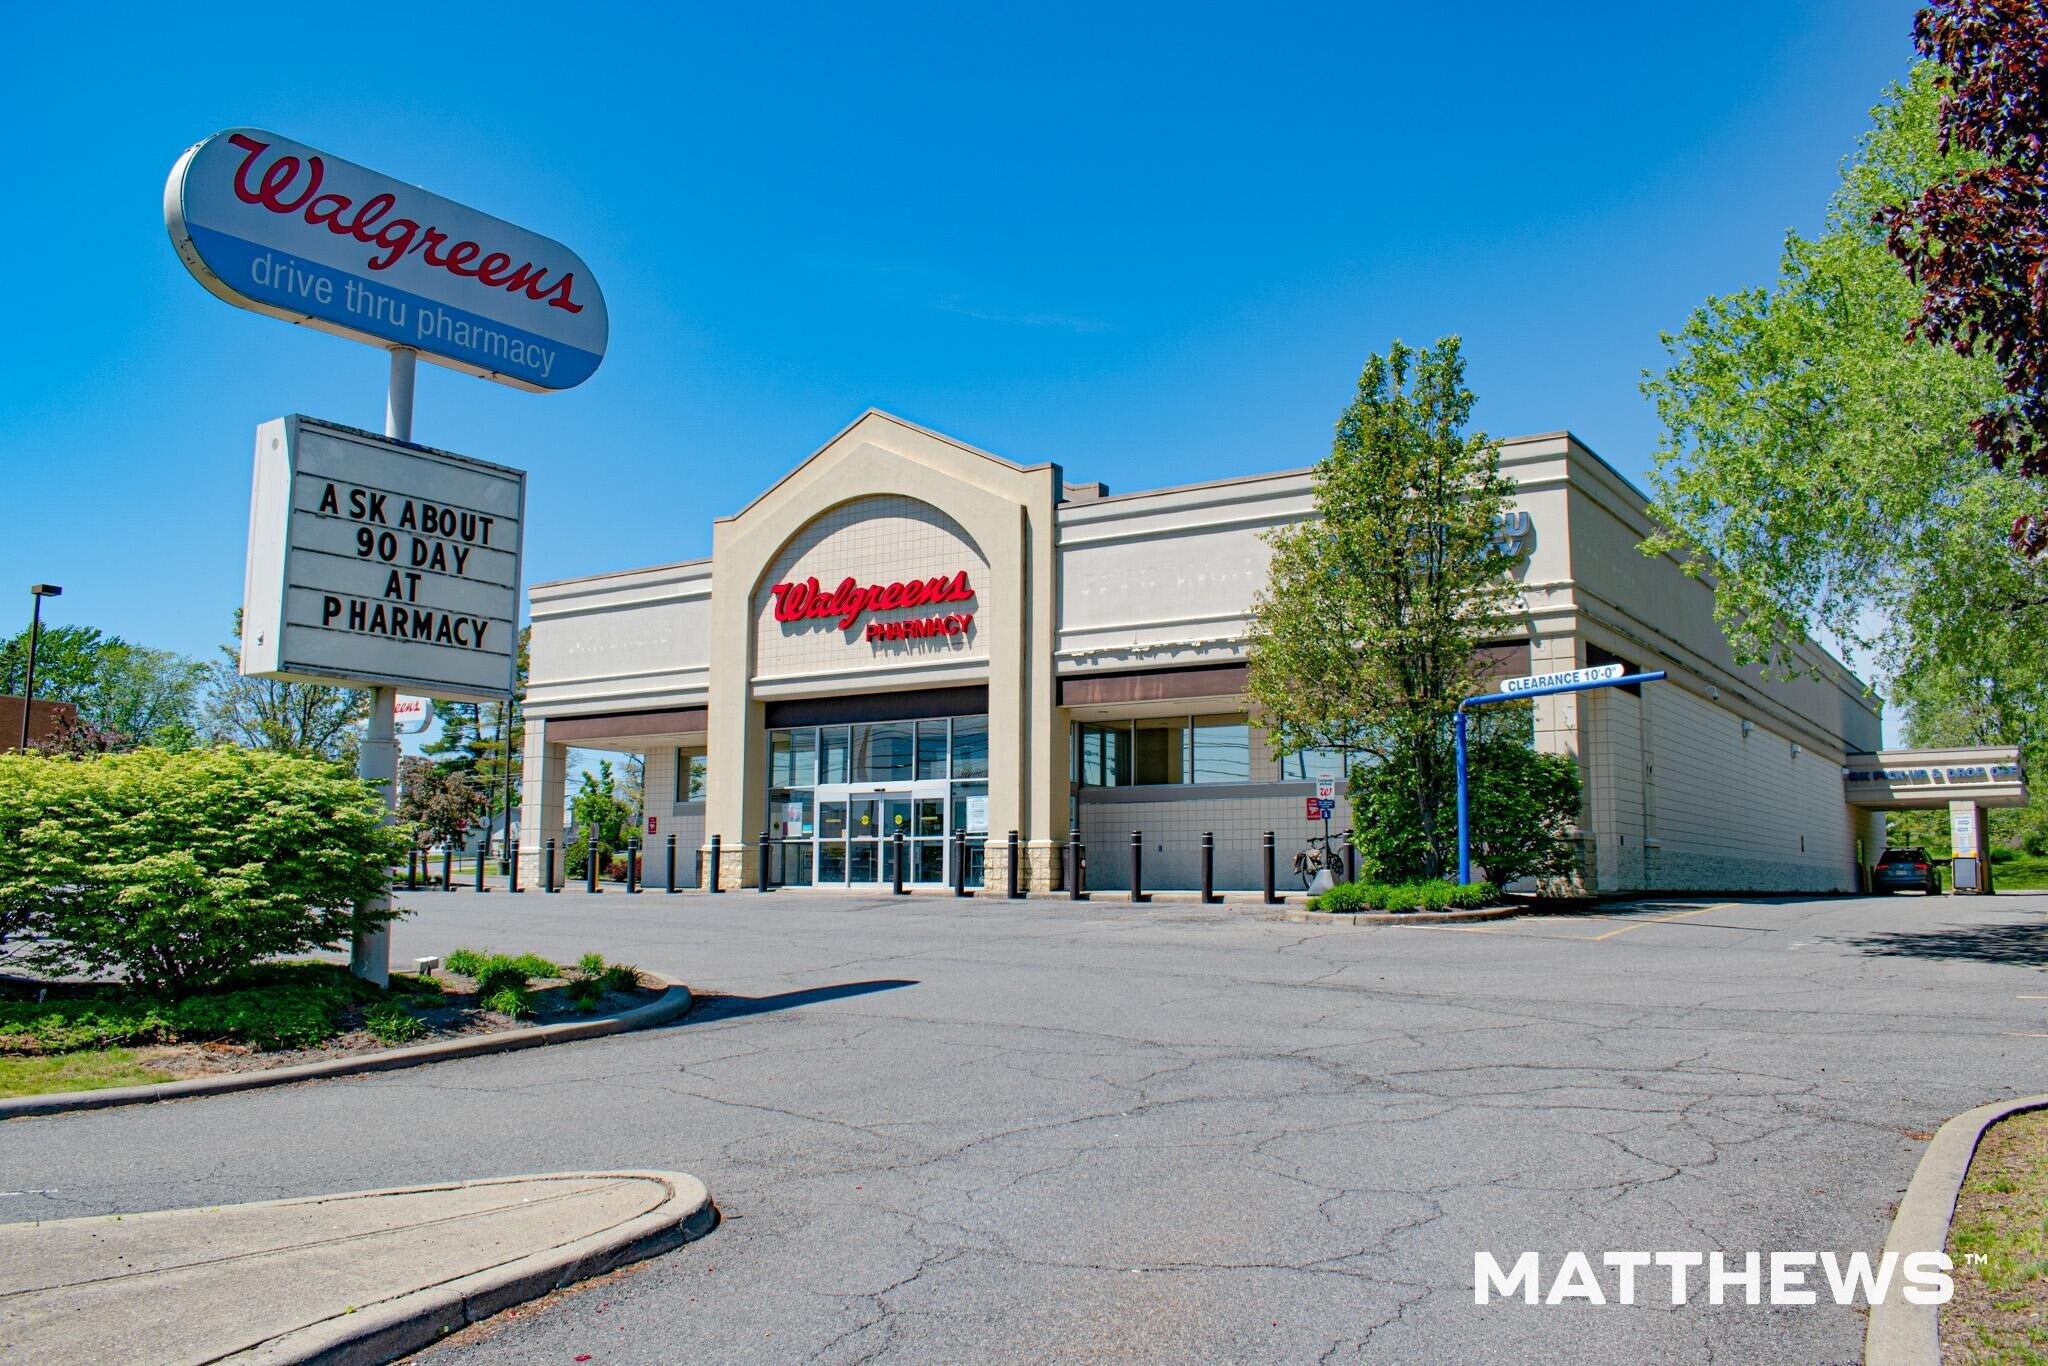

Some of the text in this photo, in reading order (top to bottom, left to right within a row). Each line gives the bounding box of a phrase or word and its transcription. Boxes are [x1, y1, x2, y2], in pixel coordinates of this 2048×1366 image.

[228, 133, 584, 314] Walgreens
[251, 253, 555, 378] drive thru pharmacy
[318, 482, 494, 545] ASK ABOUT
[356, 526, 470, 575] 90 DAY
[384, 569, 421, 602] AT
[770, 569, 976, 631] Walgreens
[322, 595, 489, 649] PHARMACY
[866, 614, 974, 643] PHARMACY
[1508, 671, 1580, 692] CLEARANCE
[394, 700, 420, 713] eens
[1947, 767, 1985, 778] DROP
